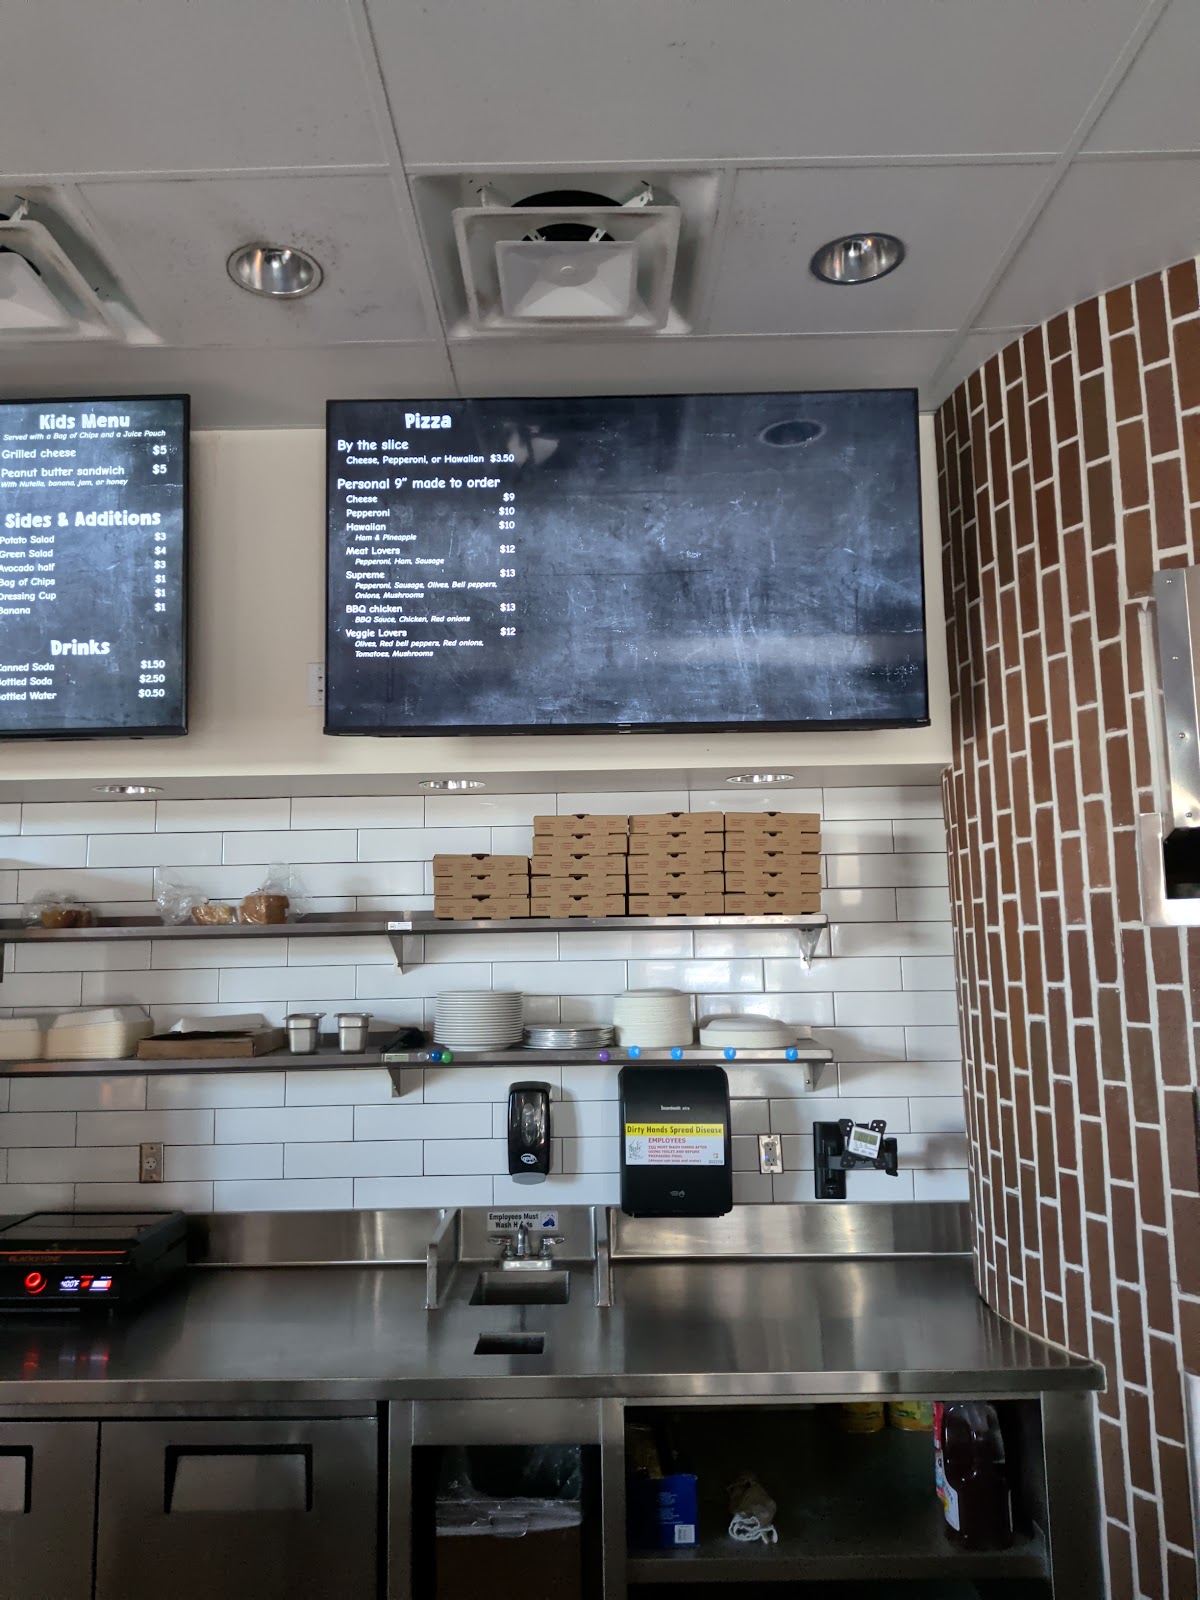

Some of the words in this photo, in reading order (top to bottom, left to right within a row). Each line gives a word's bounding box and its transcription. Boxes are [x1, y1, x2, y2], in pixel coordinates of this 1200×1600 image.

[39, 414, 76, 430] Kids
[82, 414, 130, 428] Menu
[405, 413, 452, 429] Pizza
[1, 449, 36, 459] Grilled
[40, 449, 76, 458] cheese
[152, 445, 168, 456] $5
[337, 440, 354, 453] By
[357, 440, 377, 450] the
[381, 439, 409, 450] slice
[346, 456, 380, 465] Cheese,
[383, 455, 428, 465] Pepperoni,
[444, 454, 484, 463] Hawaiian
[490, 454, 515, 463] $3.50
[1, 469, 37, 478] Peanut
[41, 467, 73, 477] butter
[77, 466, 125, 476] sandwich
[152, 464, 168, 475] $5
[106, 478, 128, 486] honey
[337, 478, 390, 490] Personal
[412, 478, 446, 489] made
[449, 478, 463, 488] to
[467, 477, 500, 488] order
[346, 495, 378, 503] Cheese
[503, 493, 515, 502] $9
[346, 509, 390, 518] Pepperoni
[499, 507, 515, 516] $10
[5, 513, 52, 529] Sides
[58, 512, 69, 527] &
[74, 510, 161, 526] Additions
[346, 523, 386, 531] Hawaiian
[499, 521, 515, 530] $10
[0, 536, 27, 545] Potato
[30, 535, 55, 544] Salad
[154, 532, 166, 541] $3
[0, 550, 25, 559] Green
[29, 549, 54, 558] Salad
[154, 546, 166, 555] $4
[345, 547, 369, 555] Meat
[371, 546, 400, 555] Lovers
[500, 545, 515, 554] $12
[0, 564, 34, 572] Avocado
[37, 563, 55, 572] half
[154, 560, 166, 569] $3
[415, 557, 445, 565] Sausage
[345, 571, 385, 580] Supreme
[500, 569, 515, 578] $13
[0, 578, 15, 588] Bag
[19, 578, 29, 586] of
[30, 577, 56, 587] Chips
[154, 574, 166, 584] $1
[38, 592, 56, 601] Cup
[154, 588, 166, 598] $1
[154, 603, 166, 612] $1
[345, 605, 367, 614] BBQ
[369, 605, 402, 613] chicken
[500, 603, 516, 612] $13
[345, 629, 375, 639] Veggie
[378, 629, 407, 637] Lovers
[500, 627, 516, 636] $12
[51, 639, 111, 656] Drinks
[443, 639, 457, 647] Red
[32, 663, 55, 671] Soda
[140, 660, 166, 669] $1.50
[0, 678, 27, 686] ottled
[29, 677, 52, 685] Soda
[139, 674, 166, 684] $2.50
[0, 692, 26, 700] ottled
[29, 691, 57, 700] Water
[138, 689, 165, 698] $0.50
[627, 1126, 644, 1134] Dirty
[670, 1126, 694, 1134] Spread
[696, 1126, 722, 1134] Disease
